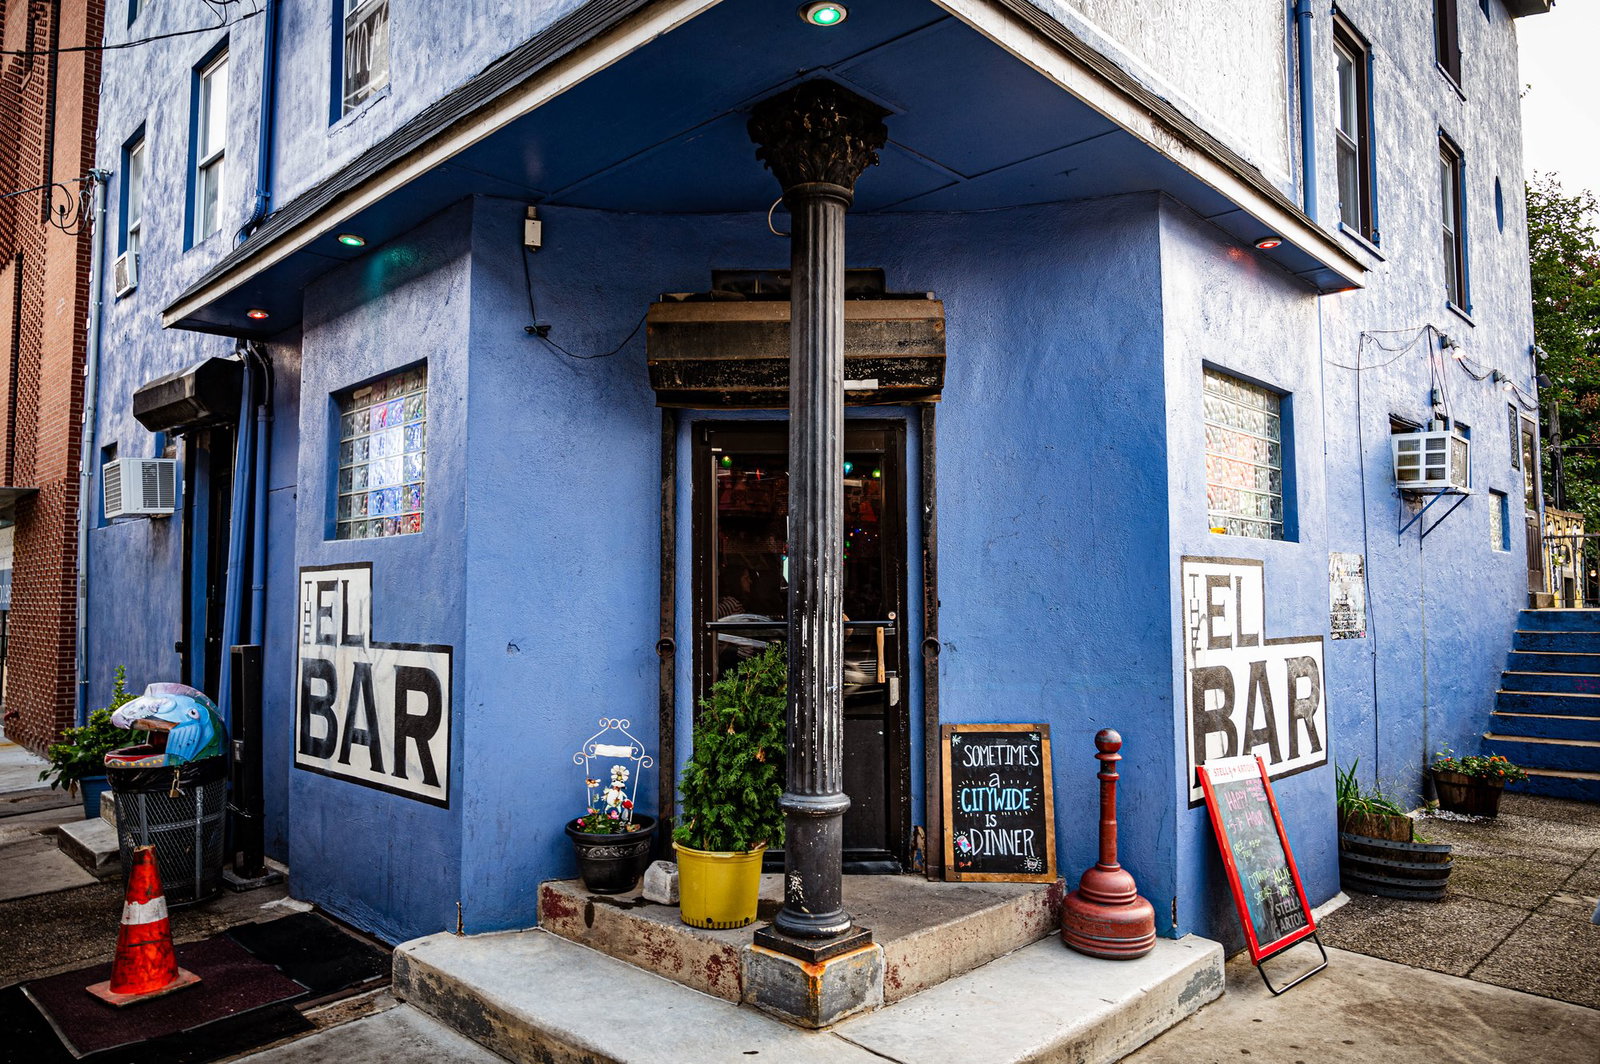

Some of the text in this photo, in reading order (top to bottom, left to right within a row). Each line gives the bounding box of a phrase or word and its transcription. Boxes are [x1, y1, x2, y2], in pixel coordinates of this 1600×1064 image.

[304, 581, 313, 644] THE
[315, 578, 365, 647] EL
[1205, 573, 1260, 650] EL
[298, 658, 442, 788] BAR
[1190, 656, 1322, 788] BAR
[962, 745, 1039, 767] SOMETIMES
[989, 772, 1000, 788] a
[961, 787, 1033, 813] CITYWIDE
[985, 813, 997, 828] IS
[970, 828, 1036, 857] DINNER
[1275, 897, 1303, 917] STELLA
[1280, 911, 1307, 932] ARTOIS
